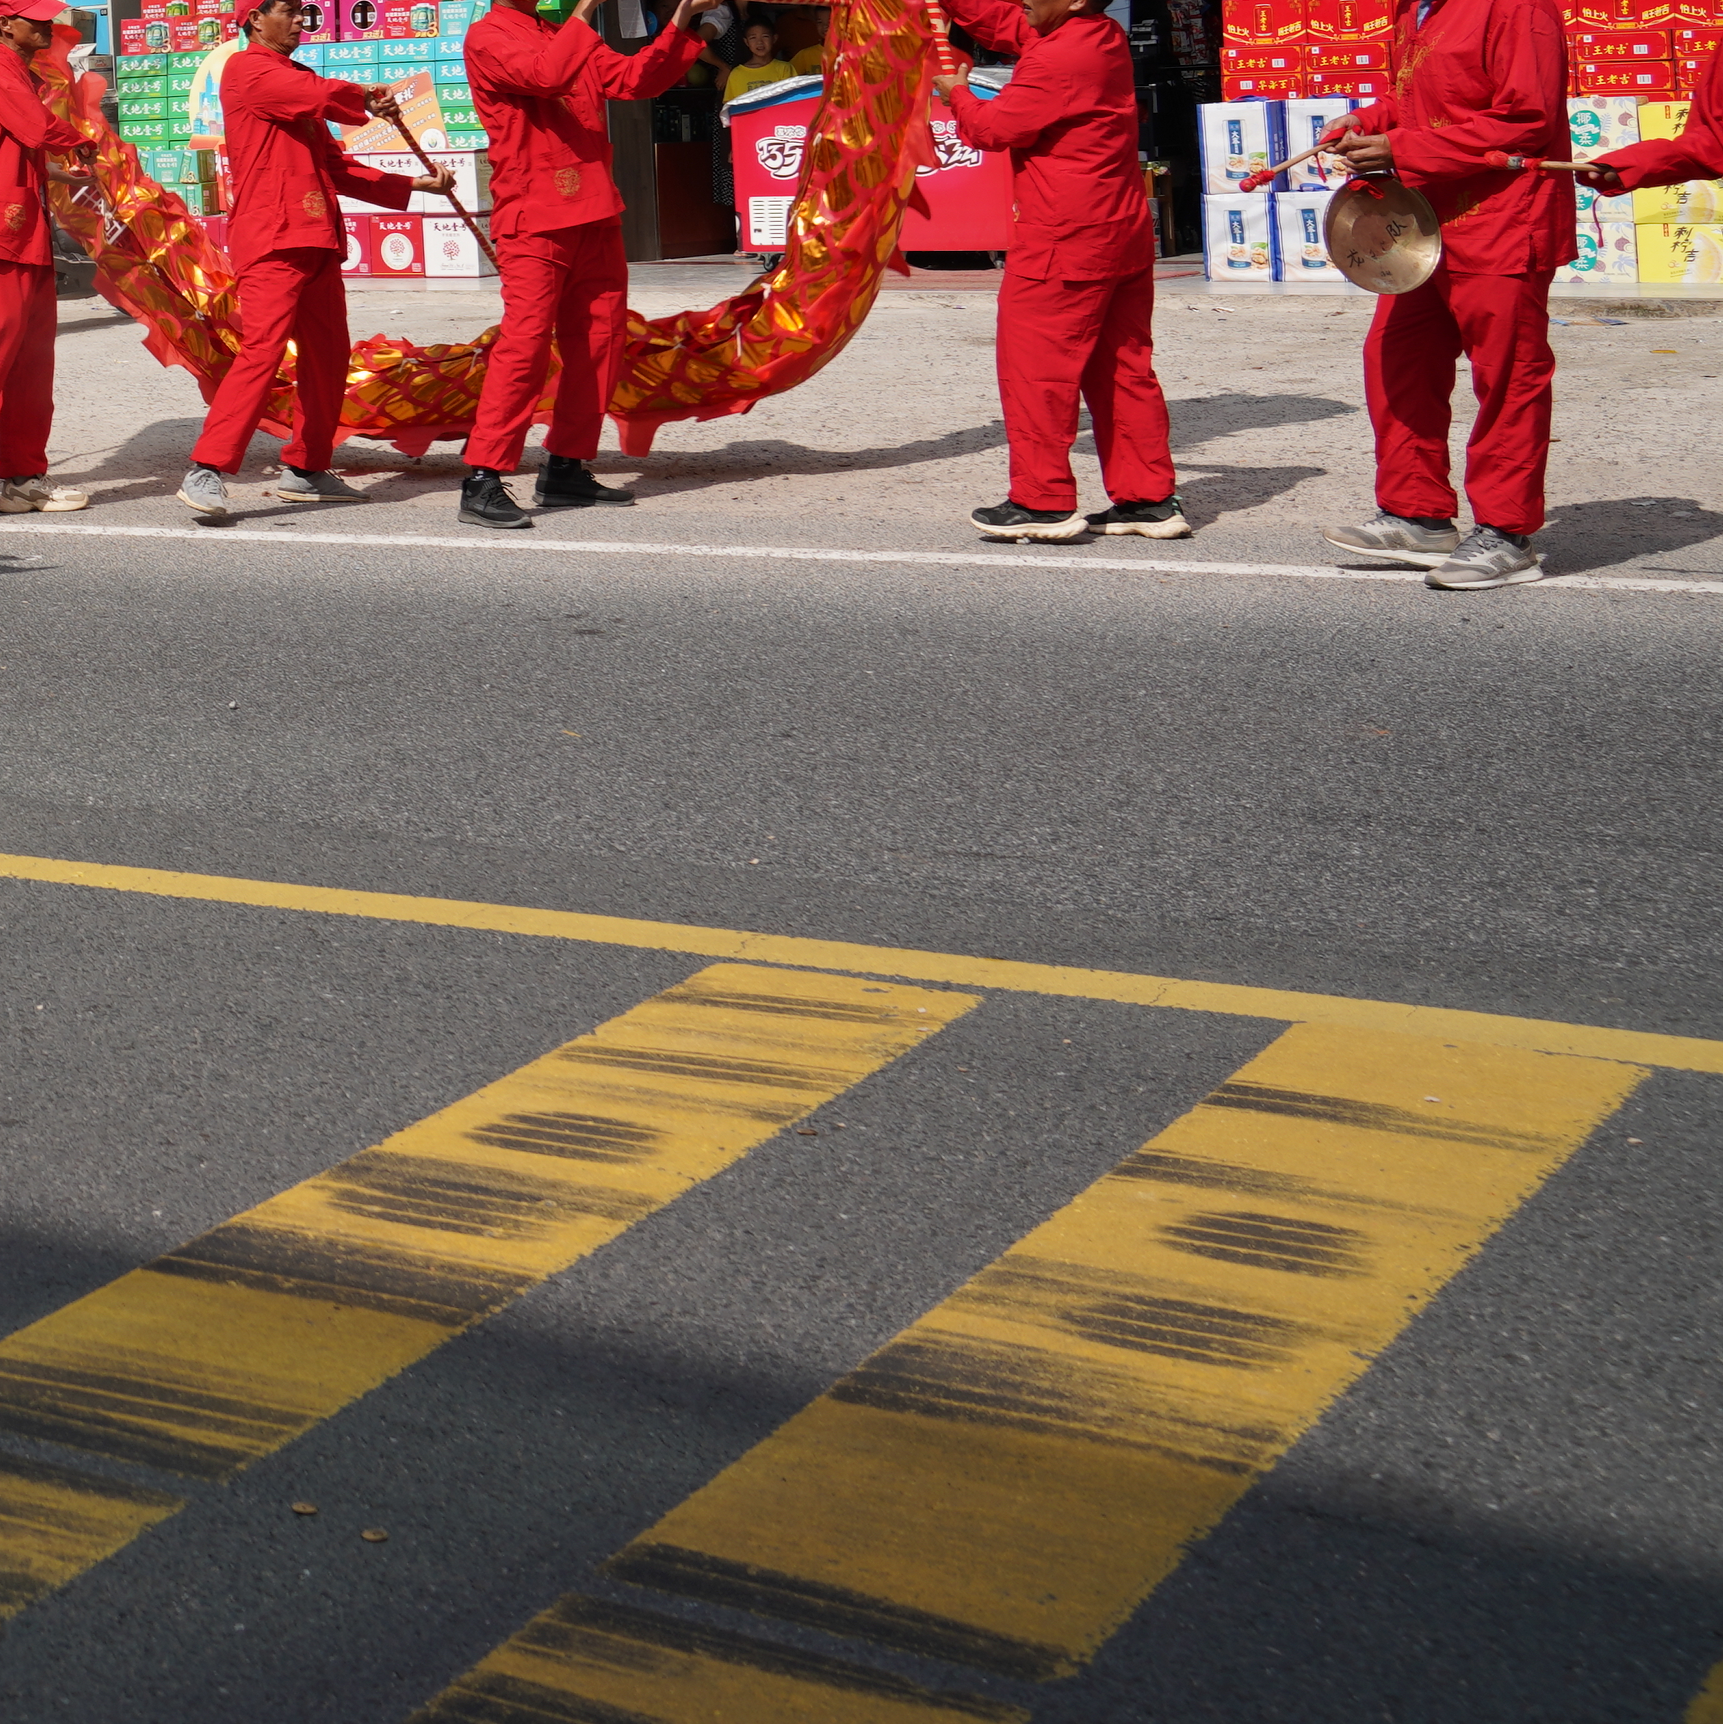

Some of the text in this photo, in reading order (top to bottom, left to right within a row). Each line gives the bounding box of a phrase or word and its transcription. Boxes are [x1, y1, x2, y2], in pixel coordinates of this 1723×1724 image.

[1582, 7, 1609, 21] 怕上火
[1679, 3, 1707, 17] 怕上火
[1227, 24, 1250, 38] 怕上火
[1310, 19, 1335, 32] 怕上火
[382, 42, 429, 56] 天地壹号
[1592, 43, 1628, 56] 王老吉
[1693, 39, 1717, 51] 王老
[328, 46, 373, 59] 天地壹号
[120, 57, 162, 72] 天地壹号
[1236, 57, 1267, 69] 王老吉
[1320, 53, 1352, 66] 王老吉
[328, 68, 373, 82] 天地壹号
[1596, 72, 1631, 86] 王老吉
[121, 79, 162, 94] 天地壹号
[1322, 82, 1354, 94] 王老吉
[121, 101, 163, 116] 天地壹号
[123, 123, 164, 137] 天地壹号
[379, 157, 412, 168] 天地壹号
[379, 221, 412, 231] 天地壹号
[433, 221, 466, 232] 天地壹号
